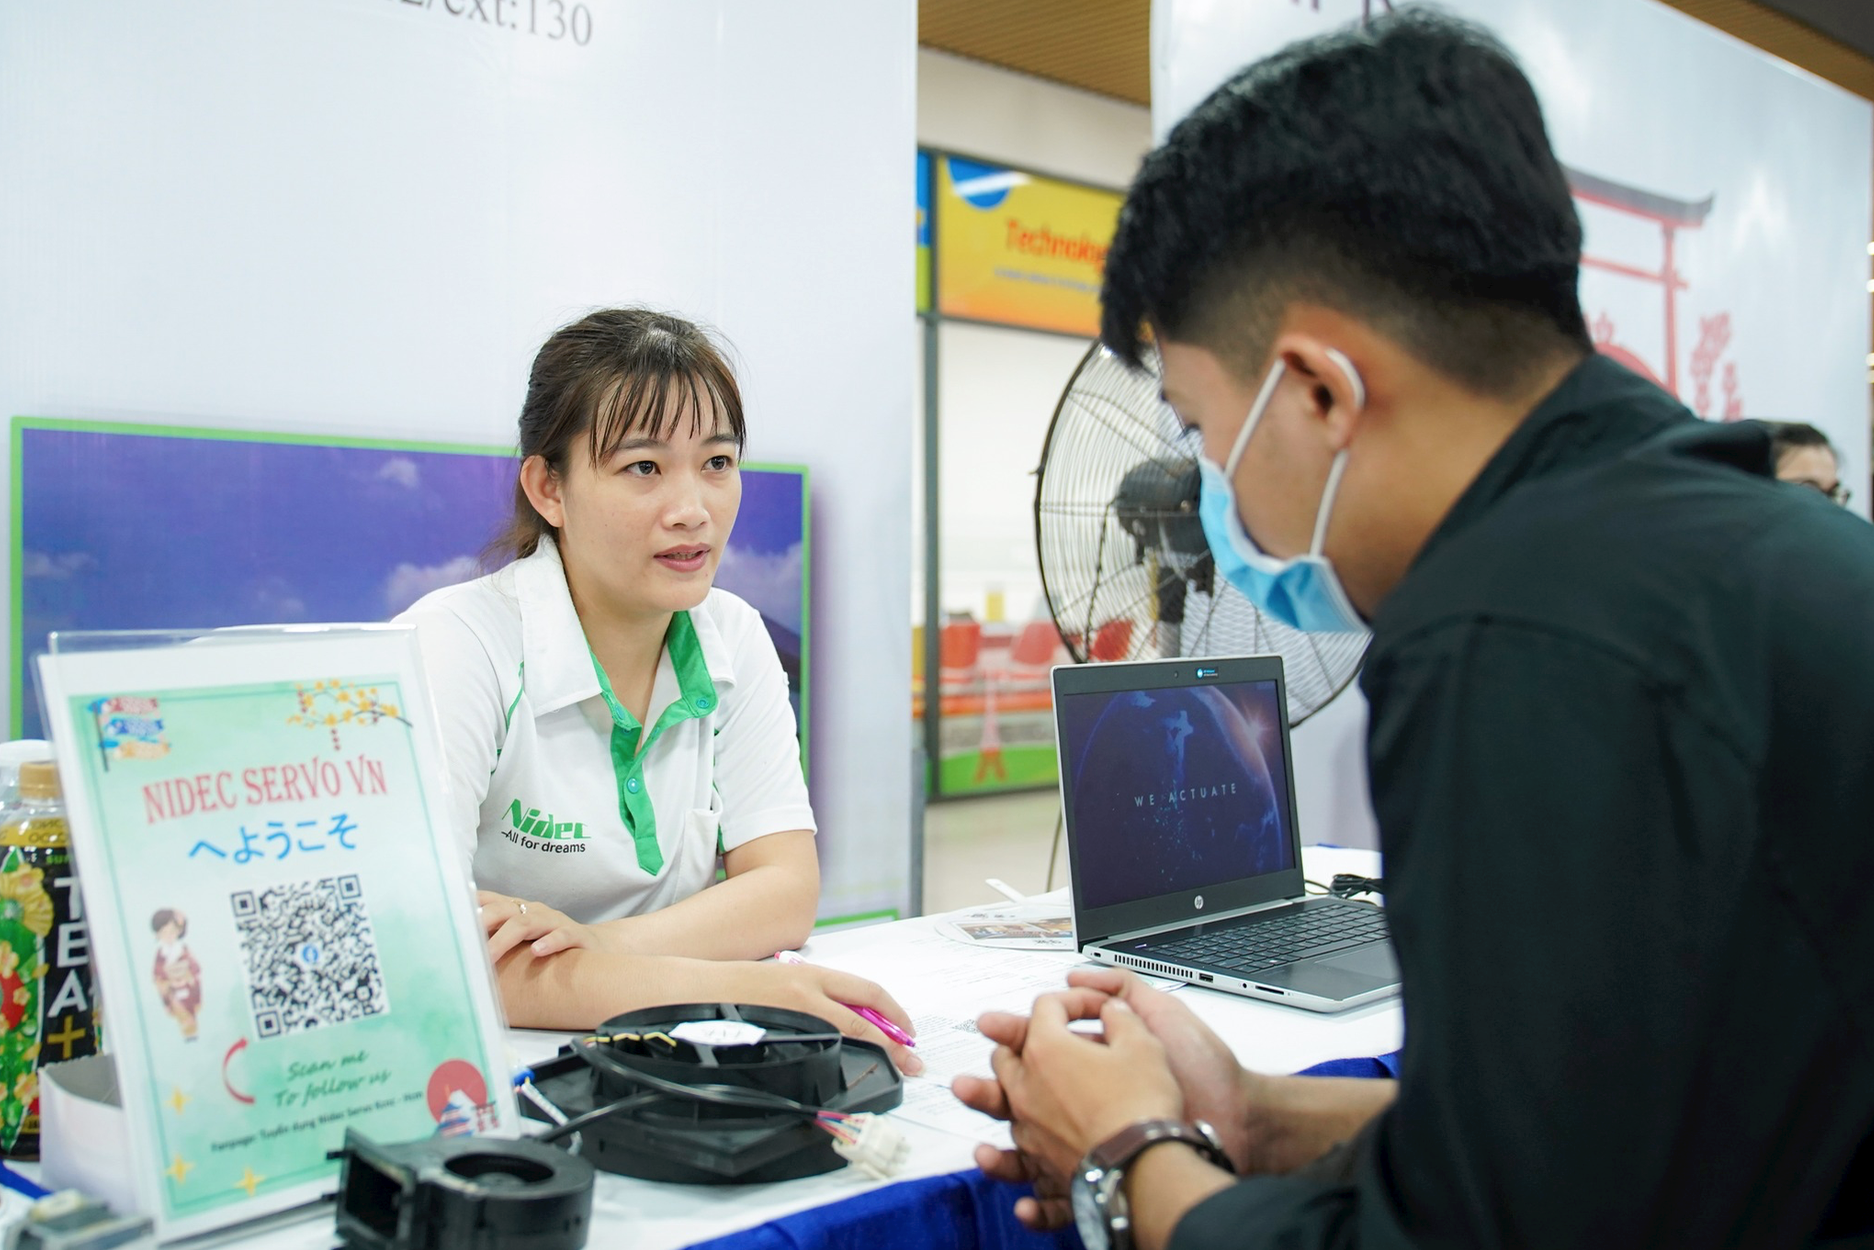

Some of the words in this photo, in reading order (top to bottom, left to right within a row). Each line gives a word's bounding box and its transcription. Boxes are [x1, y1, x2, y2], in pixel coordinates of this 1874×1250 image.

[142, 770, 237, 825] NIDEC
[243, 756, 341, 806] SERVO
[345, 754, 388, 796] VN
[1134, 794, 1155, 807] WE
[1168, 783, 1237, 803] ACTUATE
[501, 798, 592, 839] Nidec
[188, 813, 358, 864] へようこそ
[520, 836, 540, 850] for
[541, 842, 586, 853] dreams
[287, 1061, 335, 1082] Scan
[341, 1050, 369, 1068] me
[274, 1089, 299, 1108] To
[302, 1073, 365, 1107] follow
[369, 1069, 391, 1084] us
